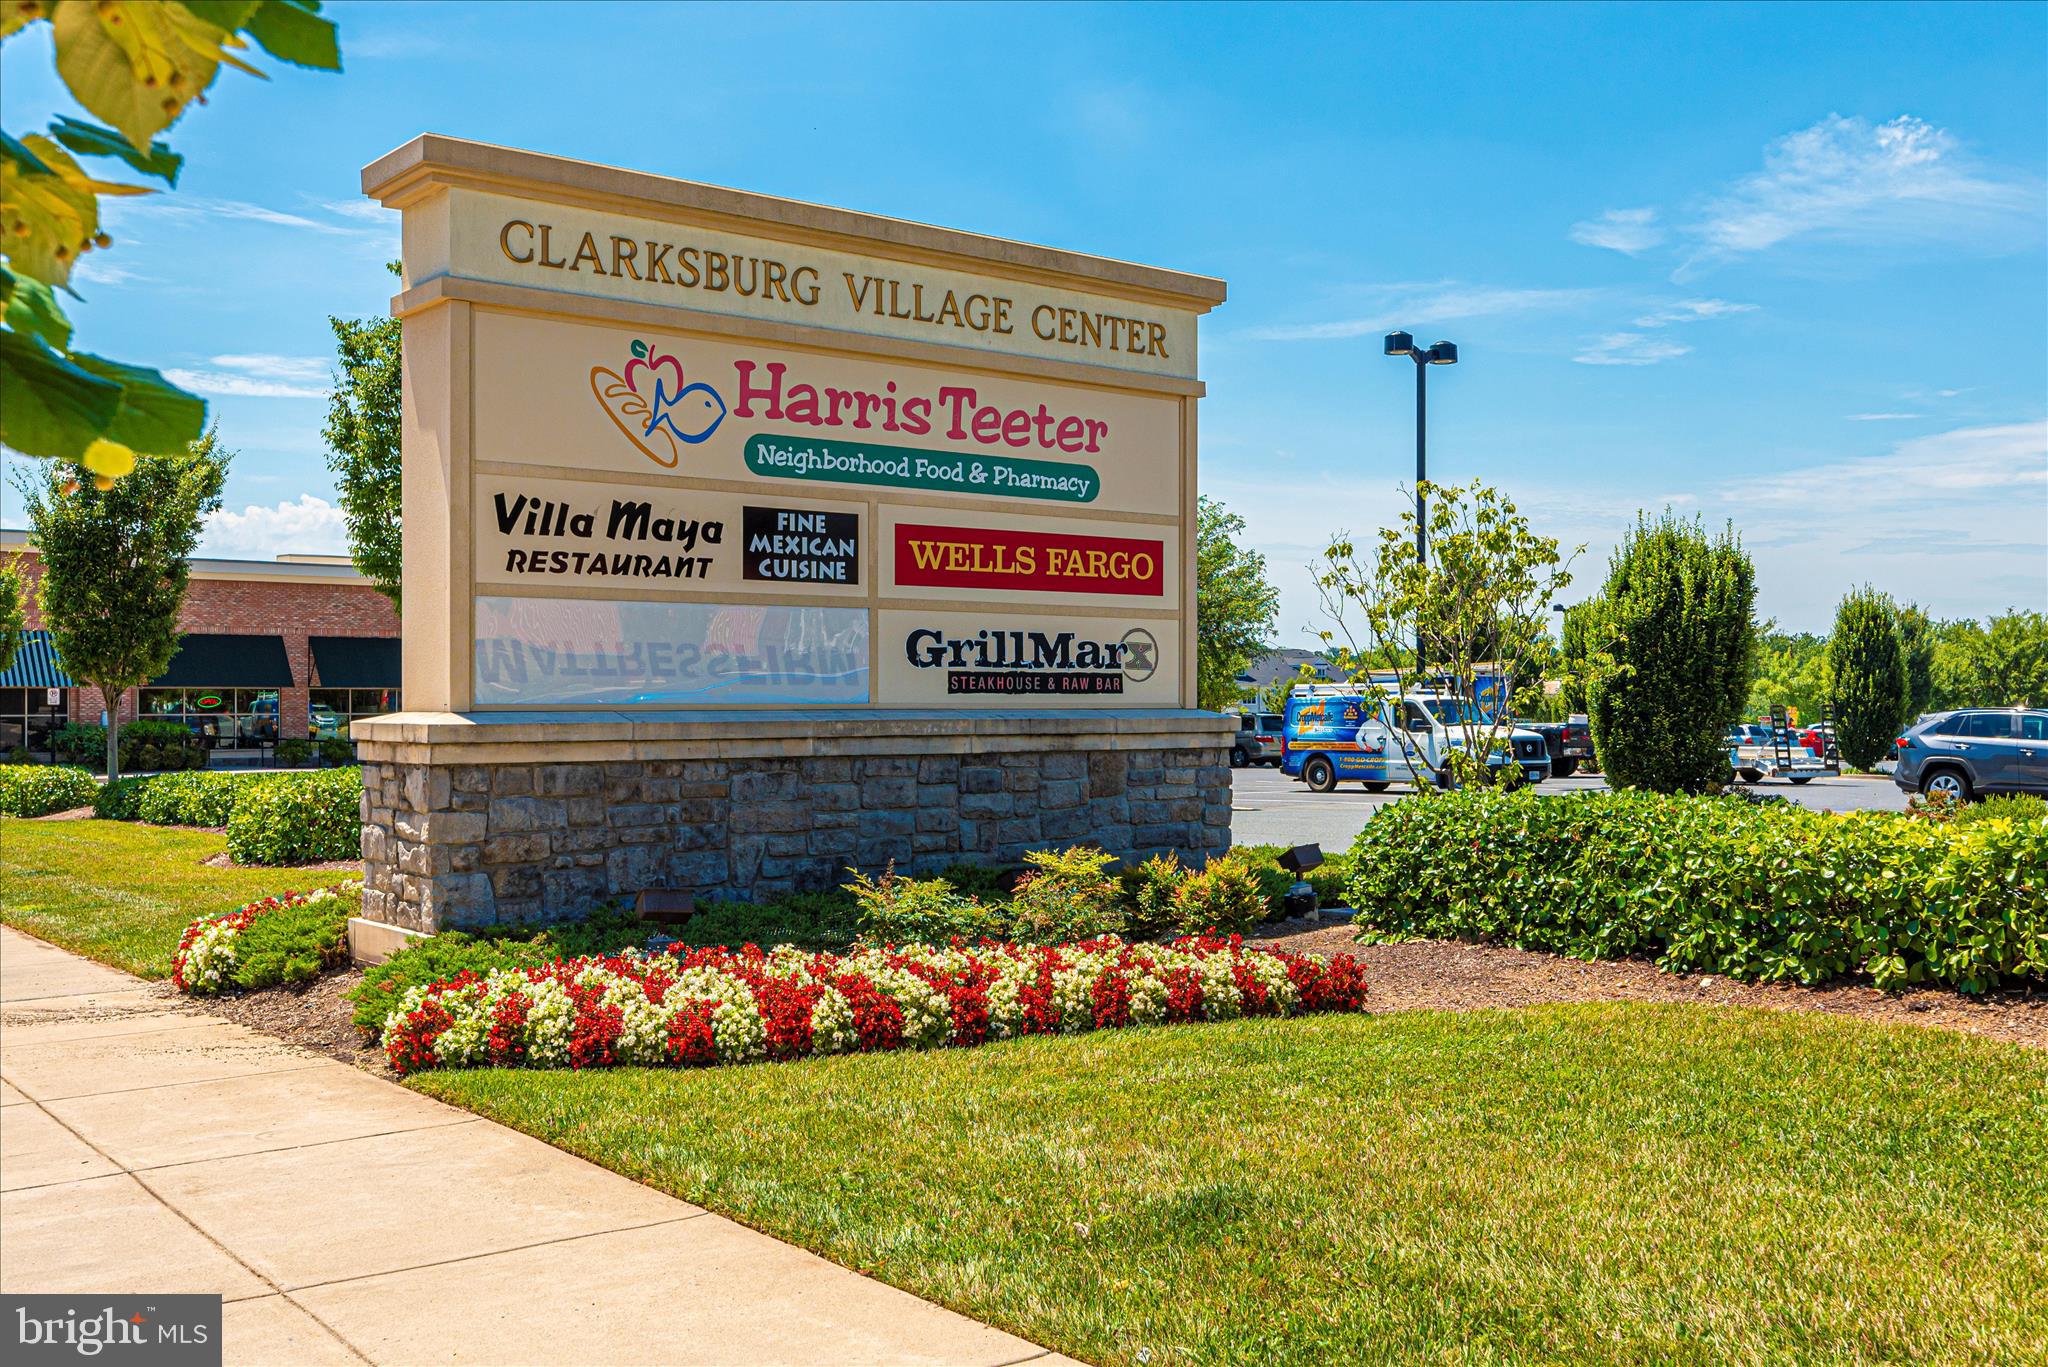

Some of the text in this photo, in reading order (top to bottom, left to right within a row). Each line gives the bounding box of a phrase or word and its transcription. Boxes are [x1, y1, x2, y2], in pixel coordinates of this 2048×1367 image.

[499, 218, 1170, 359] CLARKSBURG VILLAGE CENTER
[733, 360, 1108, 453] Harris Teeter
[757, 444, 1090, 498] Neighborhood Food & Pharmacy
[494, 492, 724, 553] Villa Maya
[777, 511, 827, 534] FINE
[505, 548, 713, 579] RESTAURANT
[749, 534, 855, 558] MEXICAN
[908, 540, 1154, 580] WELLS FARGO
[758, 558, 847, 581] CUISINE
[950, 676, 1121, 691] STEAKHOUSE & RAW BAR
